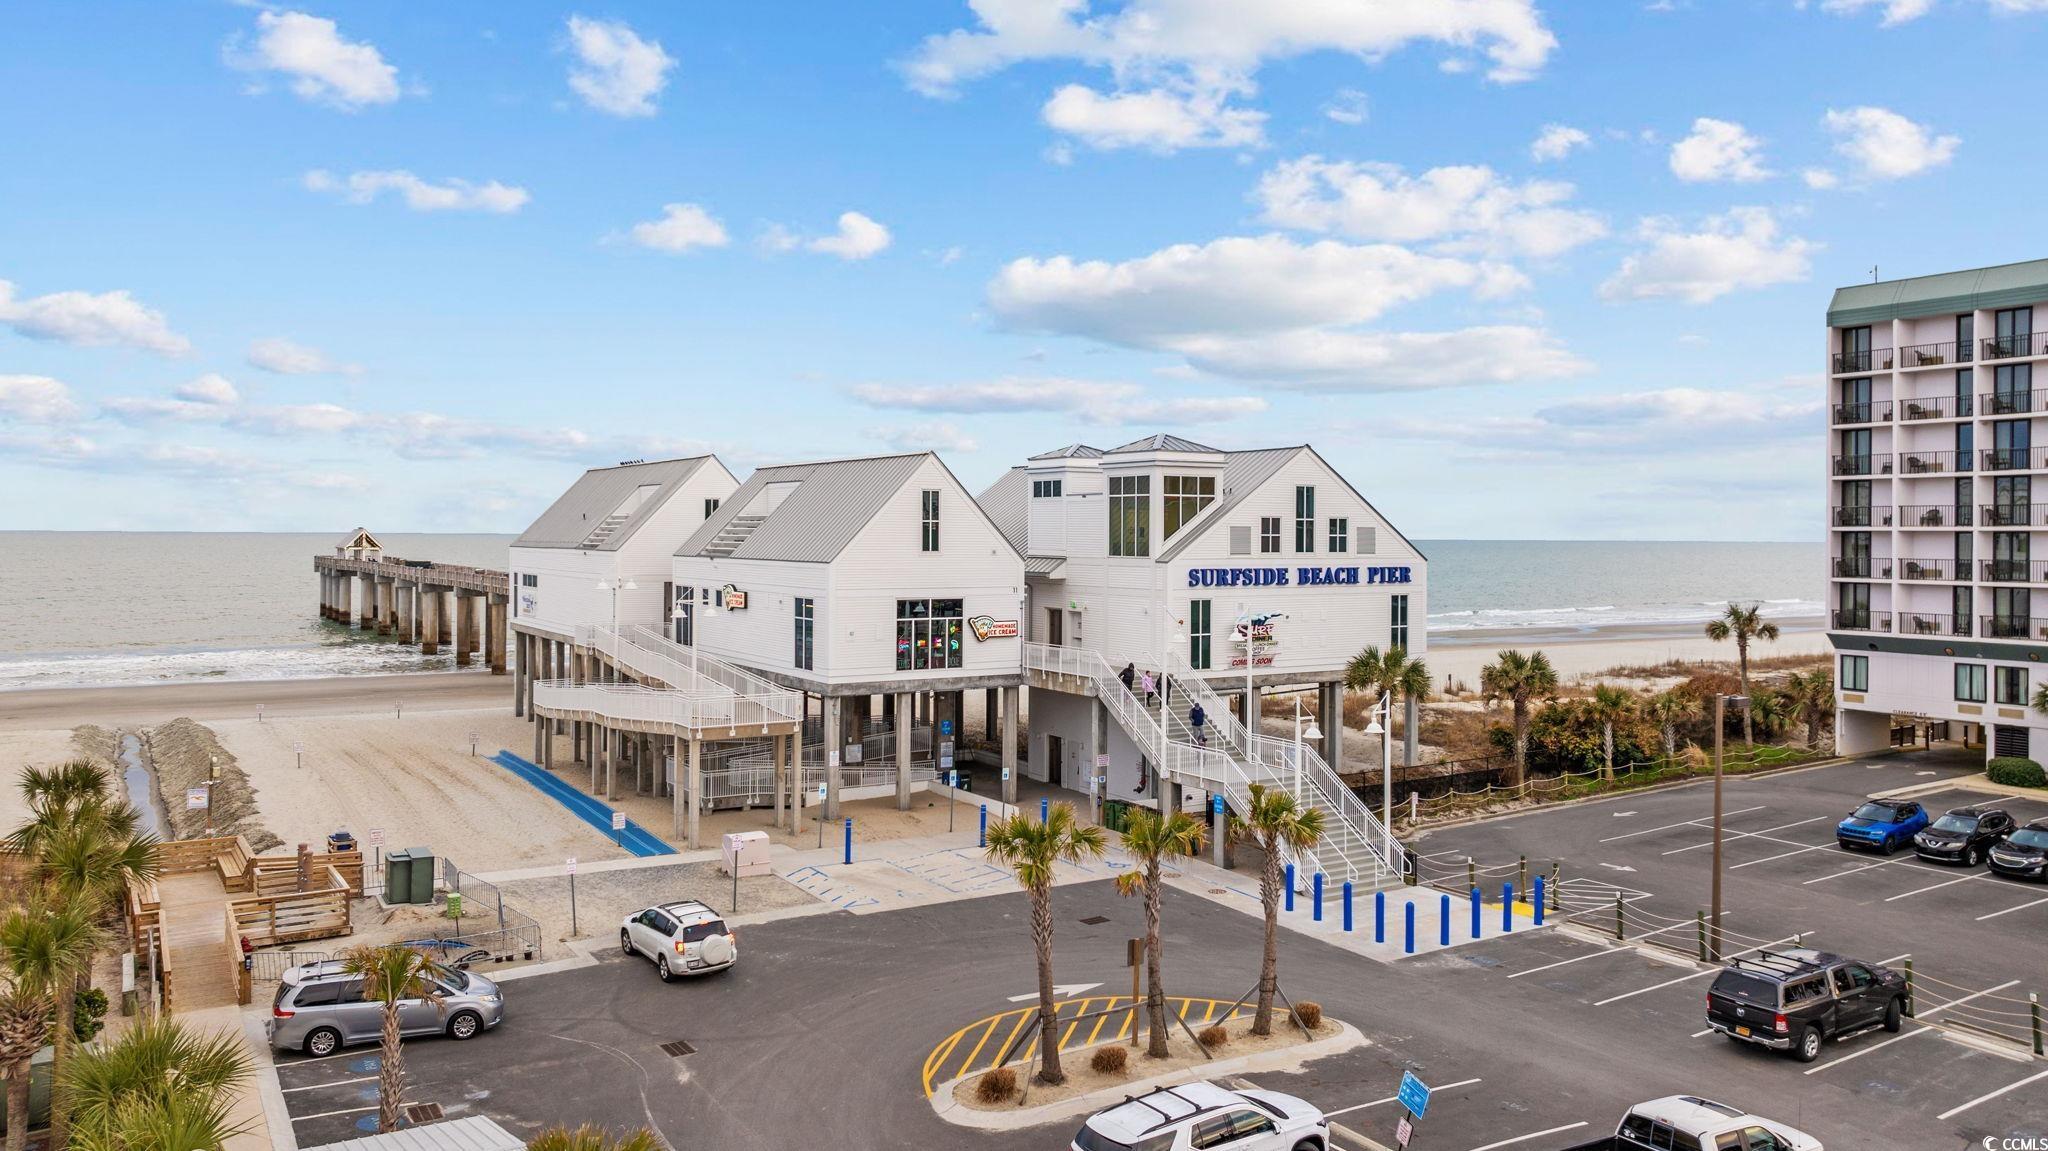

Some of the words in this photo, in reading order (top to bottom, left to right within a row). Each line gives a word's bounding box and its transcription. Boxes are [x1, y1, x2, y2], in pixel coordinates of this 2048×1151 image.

[1188, 567, 1289, 587] SURFSIDE
[1297, 566, 1360, 585] BEACH
[1367, 566, 1411, 584] PIER
[1256, 657, 1273, 665] SOON
